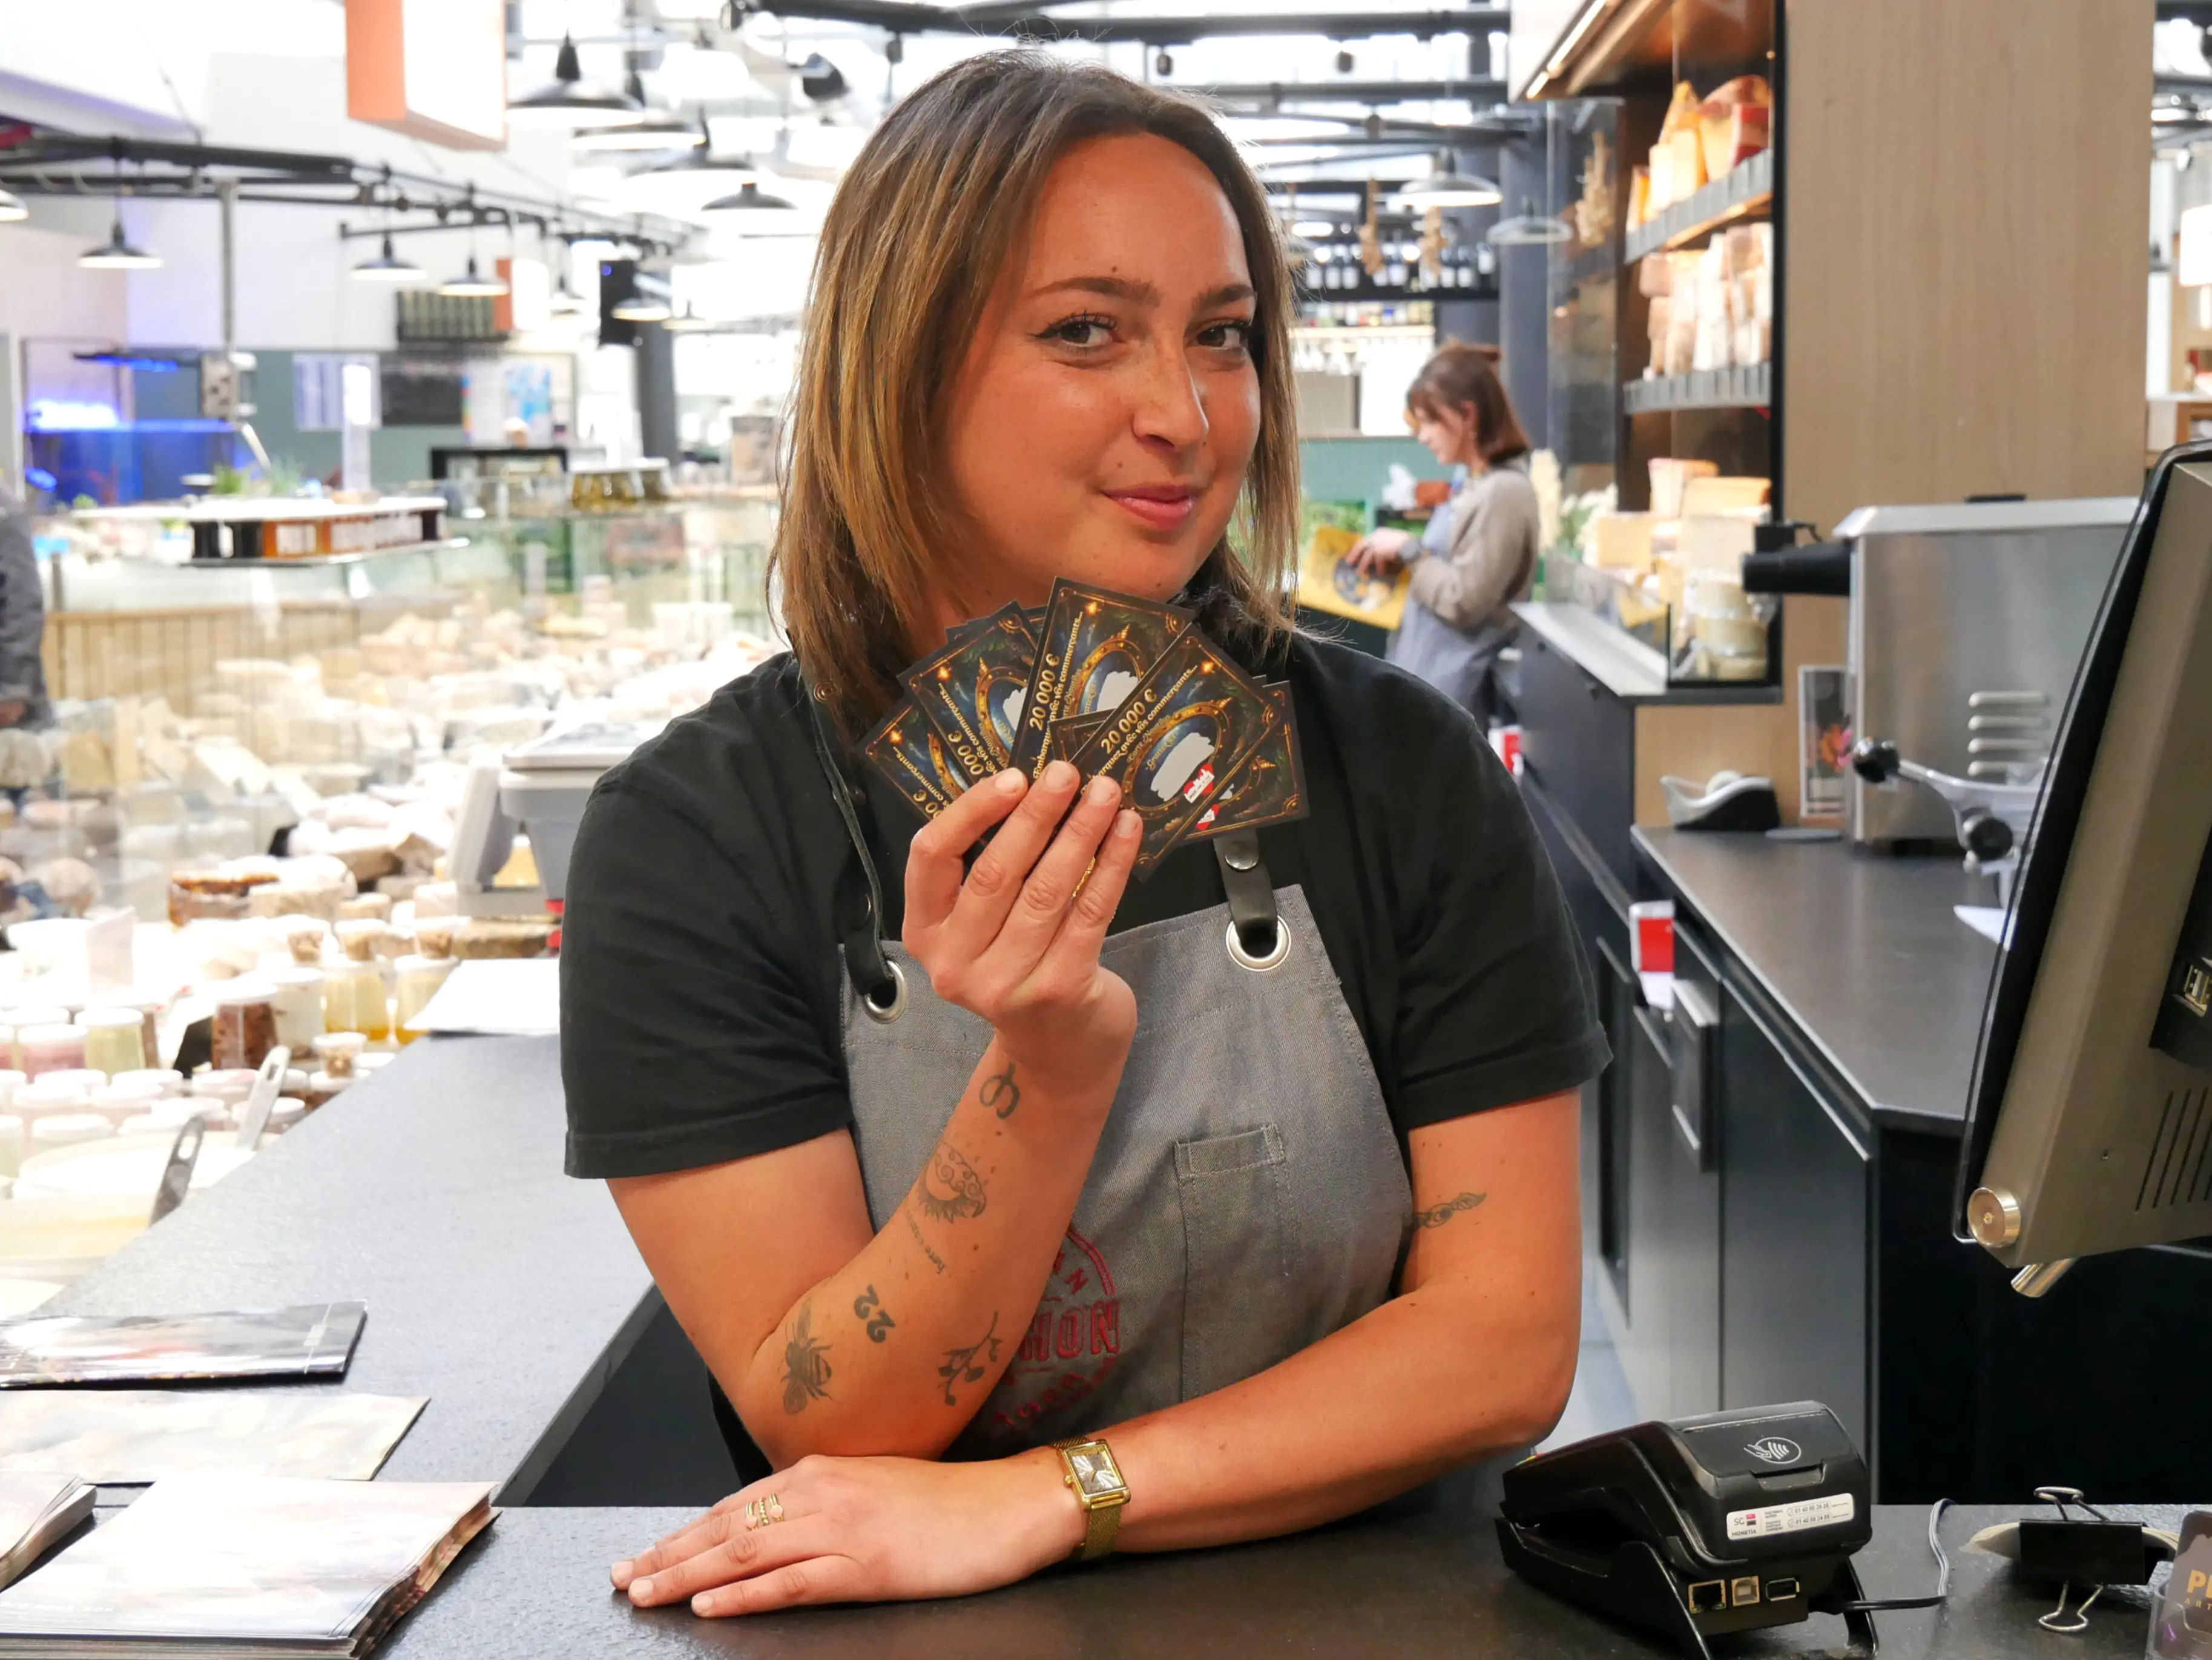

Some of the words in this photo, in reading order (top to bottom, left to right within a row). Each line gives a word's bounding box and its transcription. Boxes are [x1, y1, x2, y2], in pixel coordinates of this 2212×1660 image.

[1045, 653, 1059, 667] €
[1036, 669, 1056, 704] 000
[1029, 706, 1046, 731] 20
[1033, 726, 1051, 779] Embarque
[1053, 683, 1064, 699] vos
[1101, 730, 1121, 754] 20
[1118, 701, 1146, 733] 000
[1144, 688, 1157, 702] €
[947, 730, 963, 743] €
[1121, 733, 1137, 751] avec
[1135, 719, 1149, 734] vos
[1127, 742, 1144, 763] Carte
[1142, 714, 1171, 744] Nautilus
[957, 745, 984, 775] 000
[913, 789, 927, 802] €
[854, 1283, 895, 1343] 22
[1734, 1517, 1745, 1526] SG
